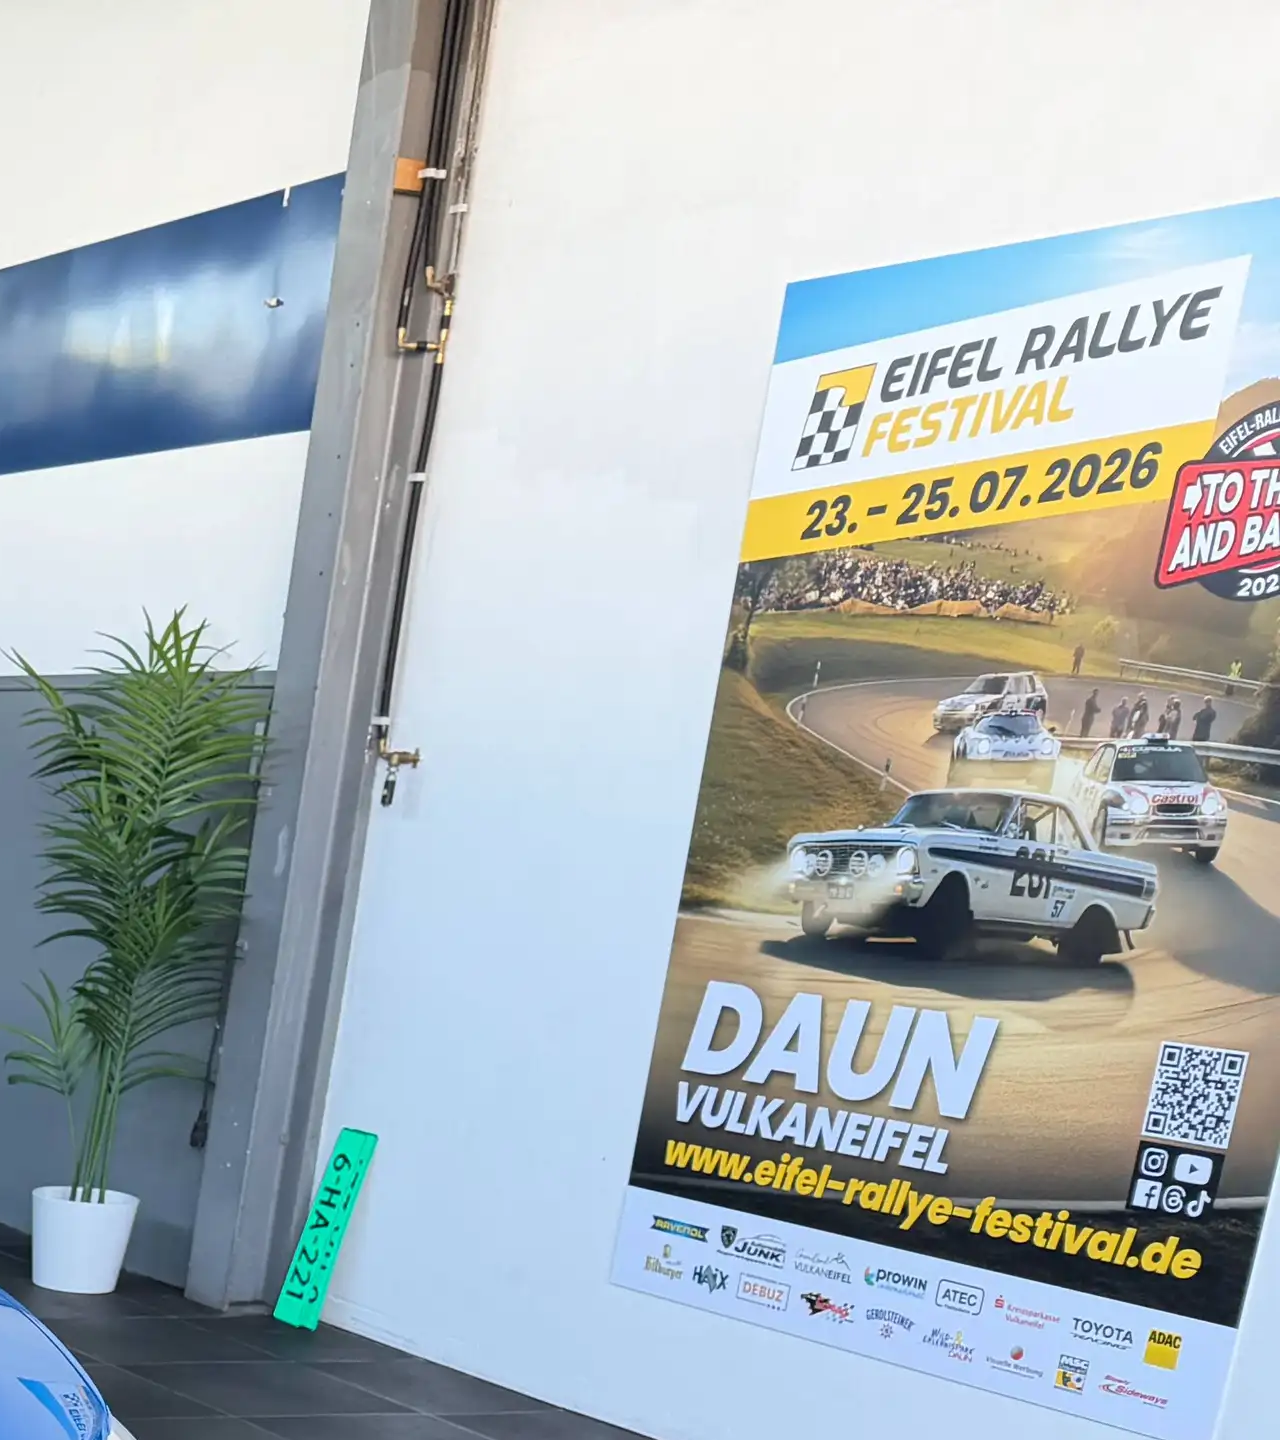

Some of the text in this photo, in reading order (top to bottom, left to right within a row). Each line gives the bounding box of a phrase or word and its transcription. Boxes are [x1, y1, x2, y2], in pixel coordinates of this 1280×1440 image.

[880, 286, 1223, 403] EIFEL RALLYE
[861, 375, 1074, 457] FESTIVAL
[1202, 472, 1245, 518] TO
[1168, 520, 1237, 573] AND
[1151, 794, 1199, 805] Castrol
[1051, 900, 1066, 918] 57
[680, 980, 1000, 1119] DAUN
[675, 1081, 950, 1175] VULKANEIFEL
[664, 1139, 1203, 1280] www.eifel-rallye-festival.de
[655, 1218, 704, 1239] RAVENOL
[734, 1241, 781, 1262] JUNK
[794, 1260, 852, 1284] VULKANEIFEL
[742, 1281, 785, 1302] DEBUZ
[942, 1288, 978, 1307] ATEC
[1072, 1318, 1133, 1344] TOYOTA
[1148, 1330, 1182, 1349] ADAC
[1115, 1384, 1168, 1405] Sideways
